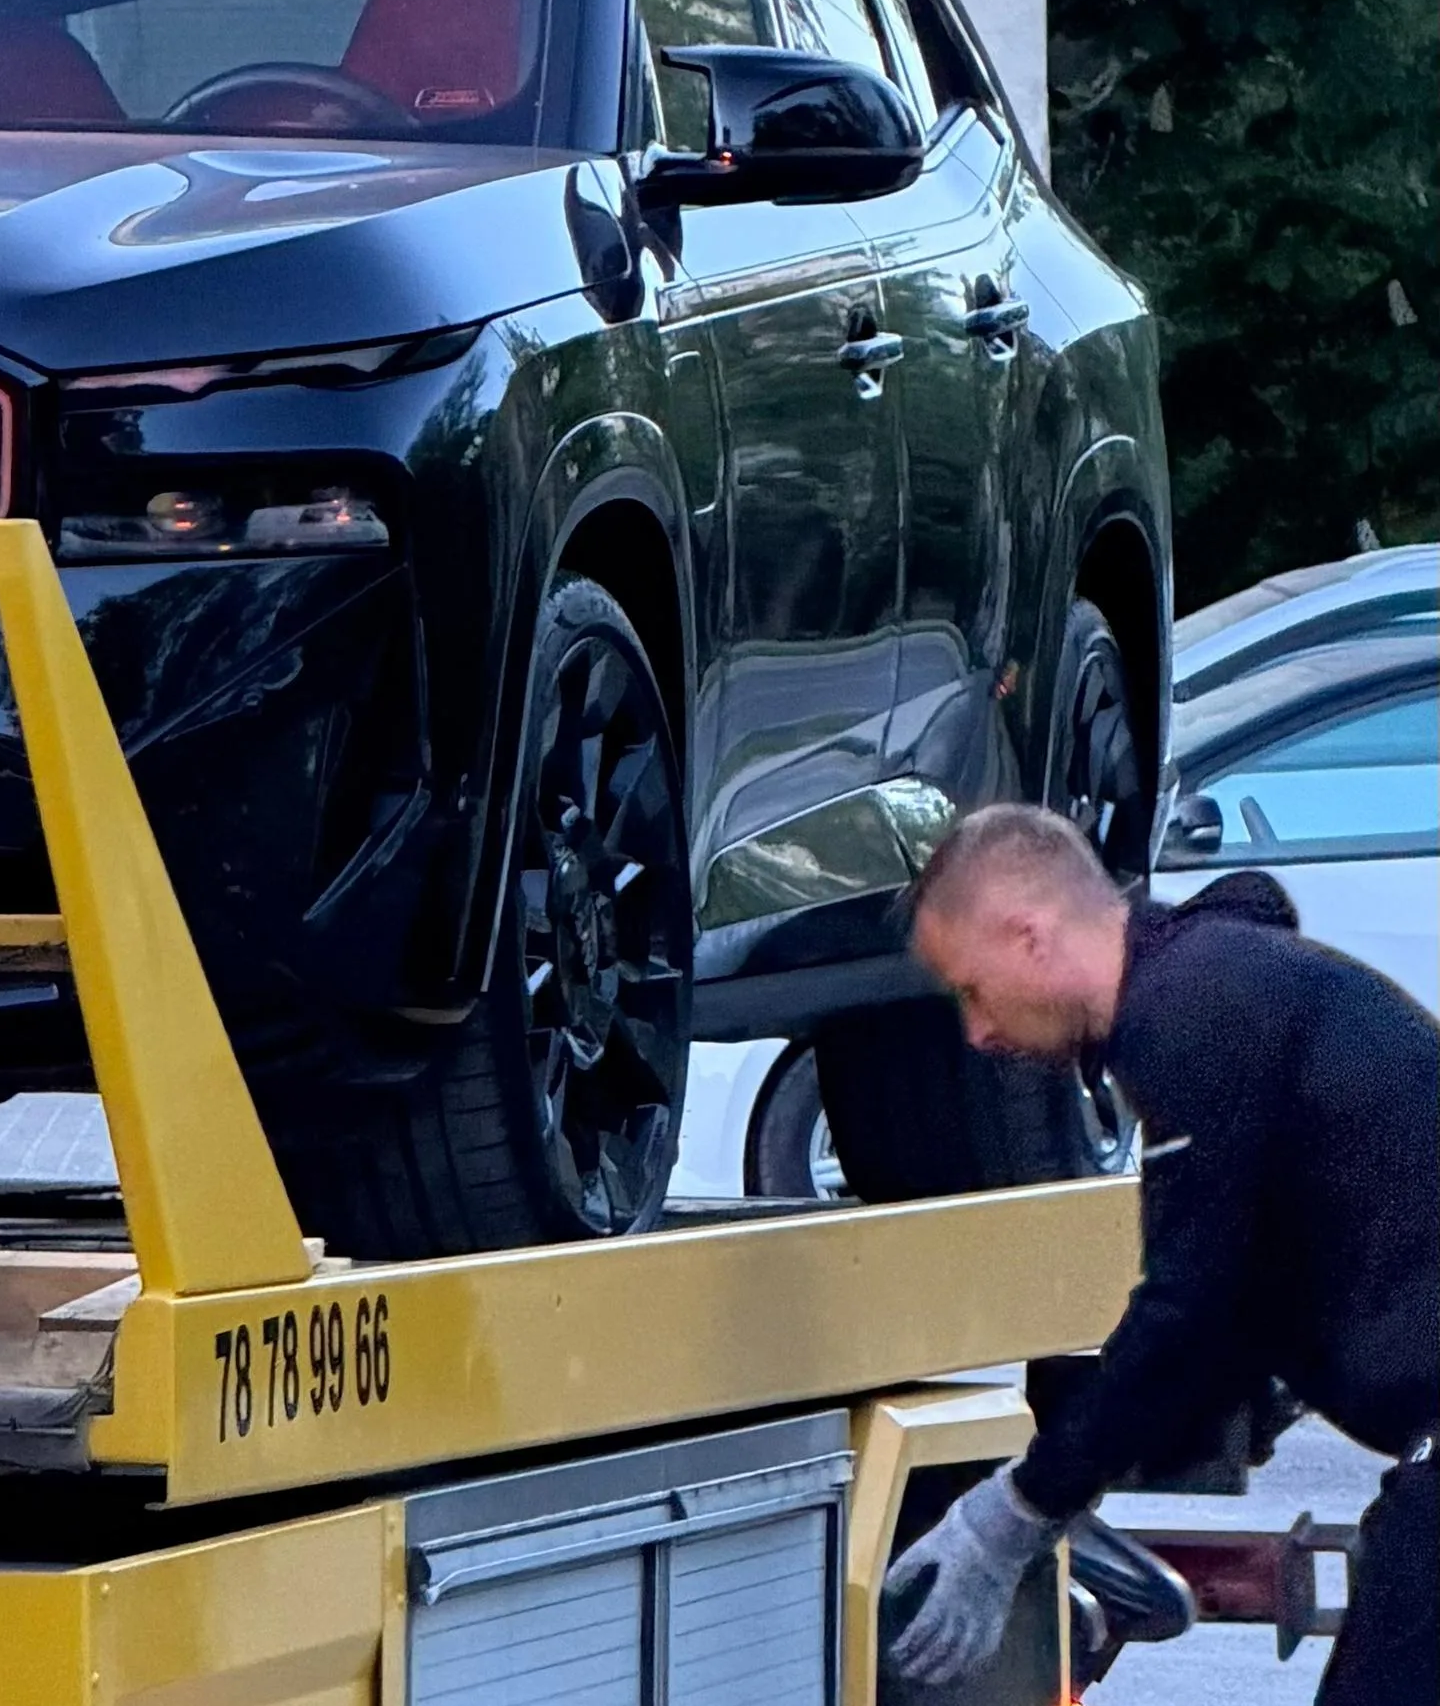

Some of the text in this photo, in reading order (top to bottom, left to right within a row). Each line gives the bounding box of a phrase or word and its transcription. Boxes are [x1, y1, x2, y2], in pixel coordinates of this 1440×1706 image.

[215, 1294, 390, 1443] 78 78 99 66
